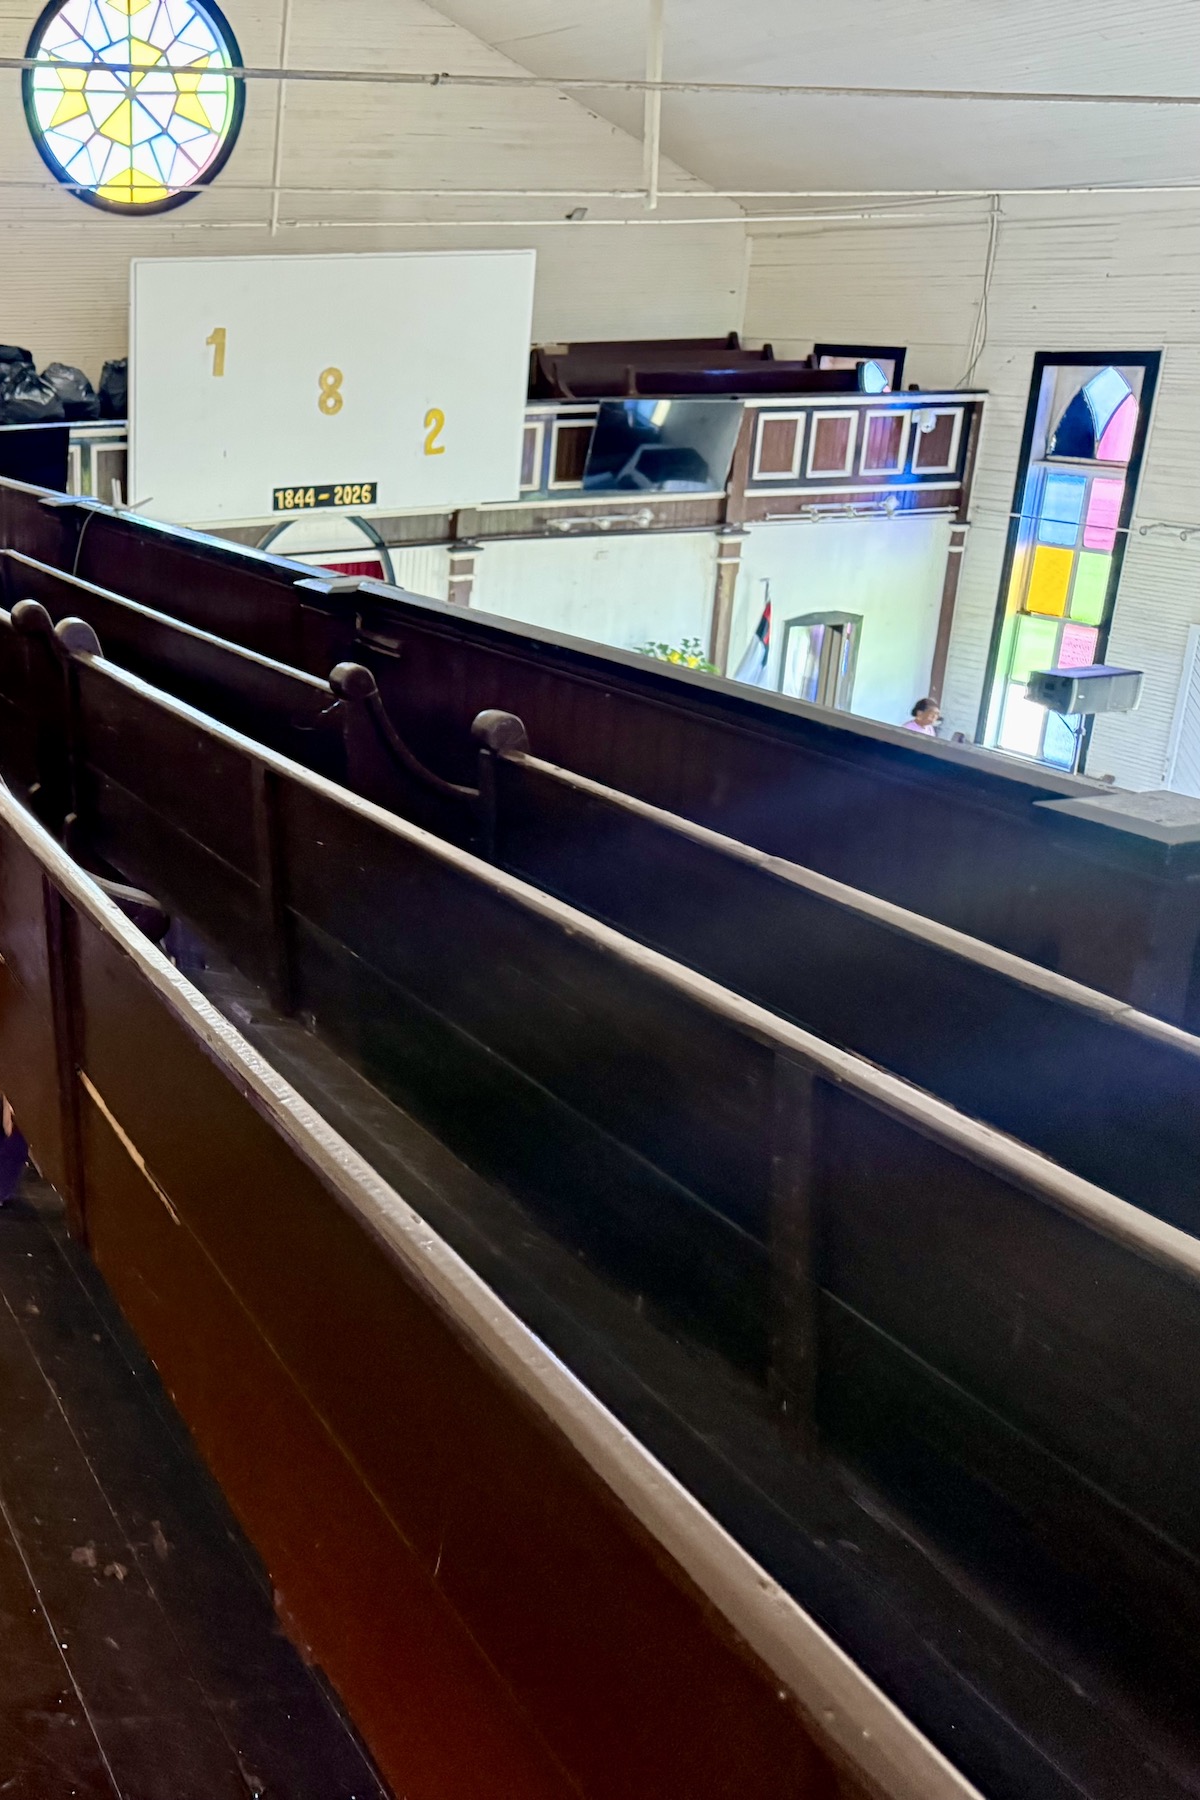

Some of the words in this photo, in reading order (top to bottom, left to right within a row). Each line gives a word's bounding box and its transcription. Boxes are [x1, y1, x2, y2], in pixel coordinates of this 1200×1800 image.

[206, 327, 226, 376] 1
[318, 367, 344, 416] 8
[424, 408, 445, 456] 2
[275, 488, 315, 509] 1844
[334, 484, 371, 504] 2026
